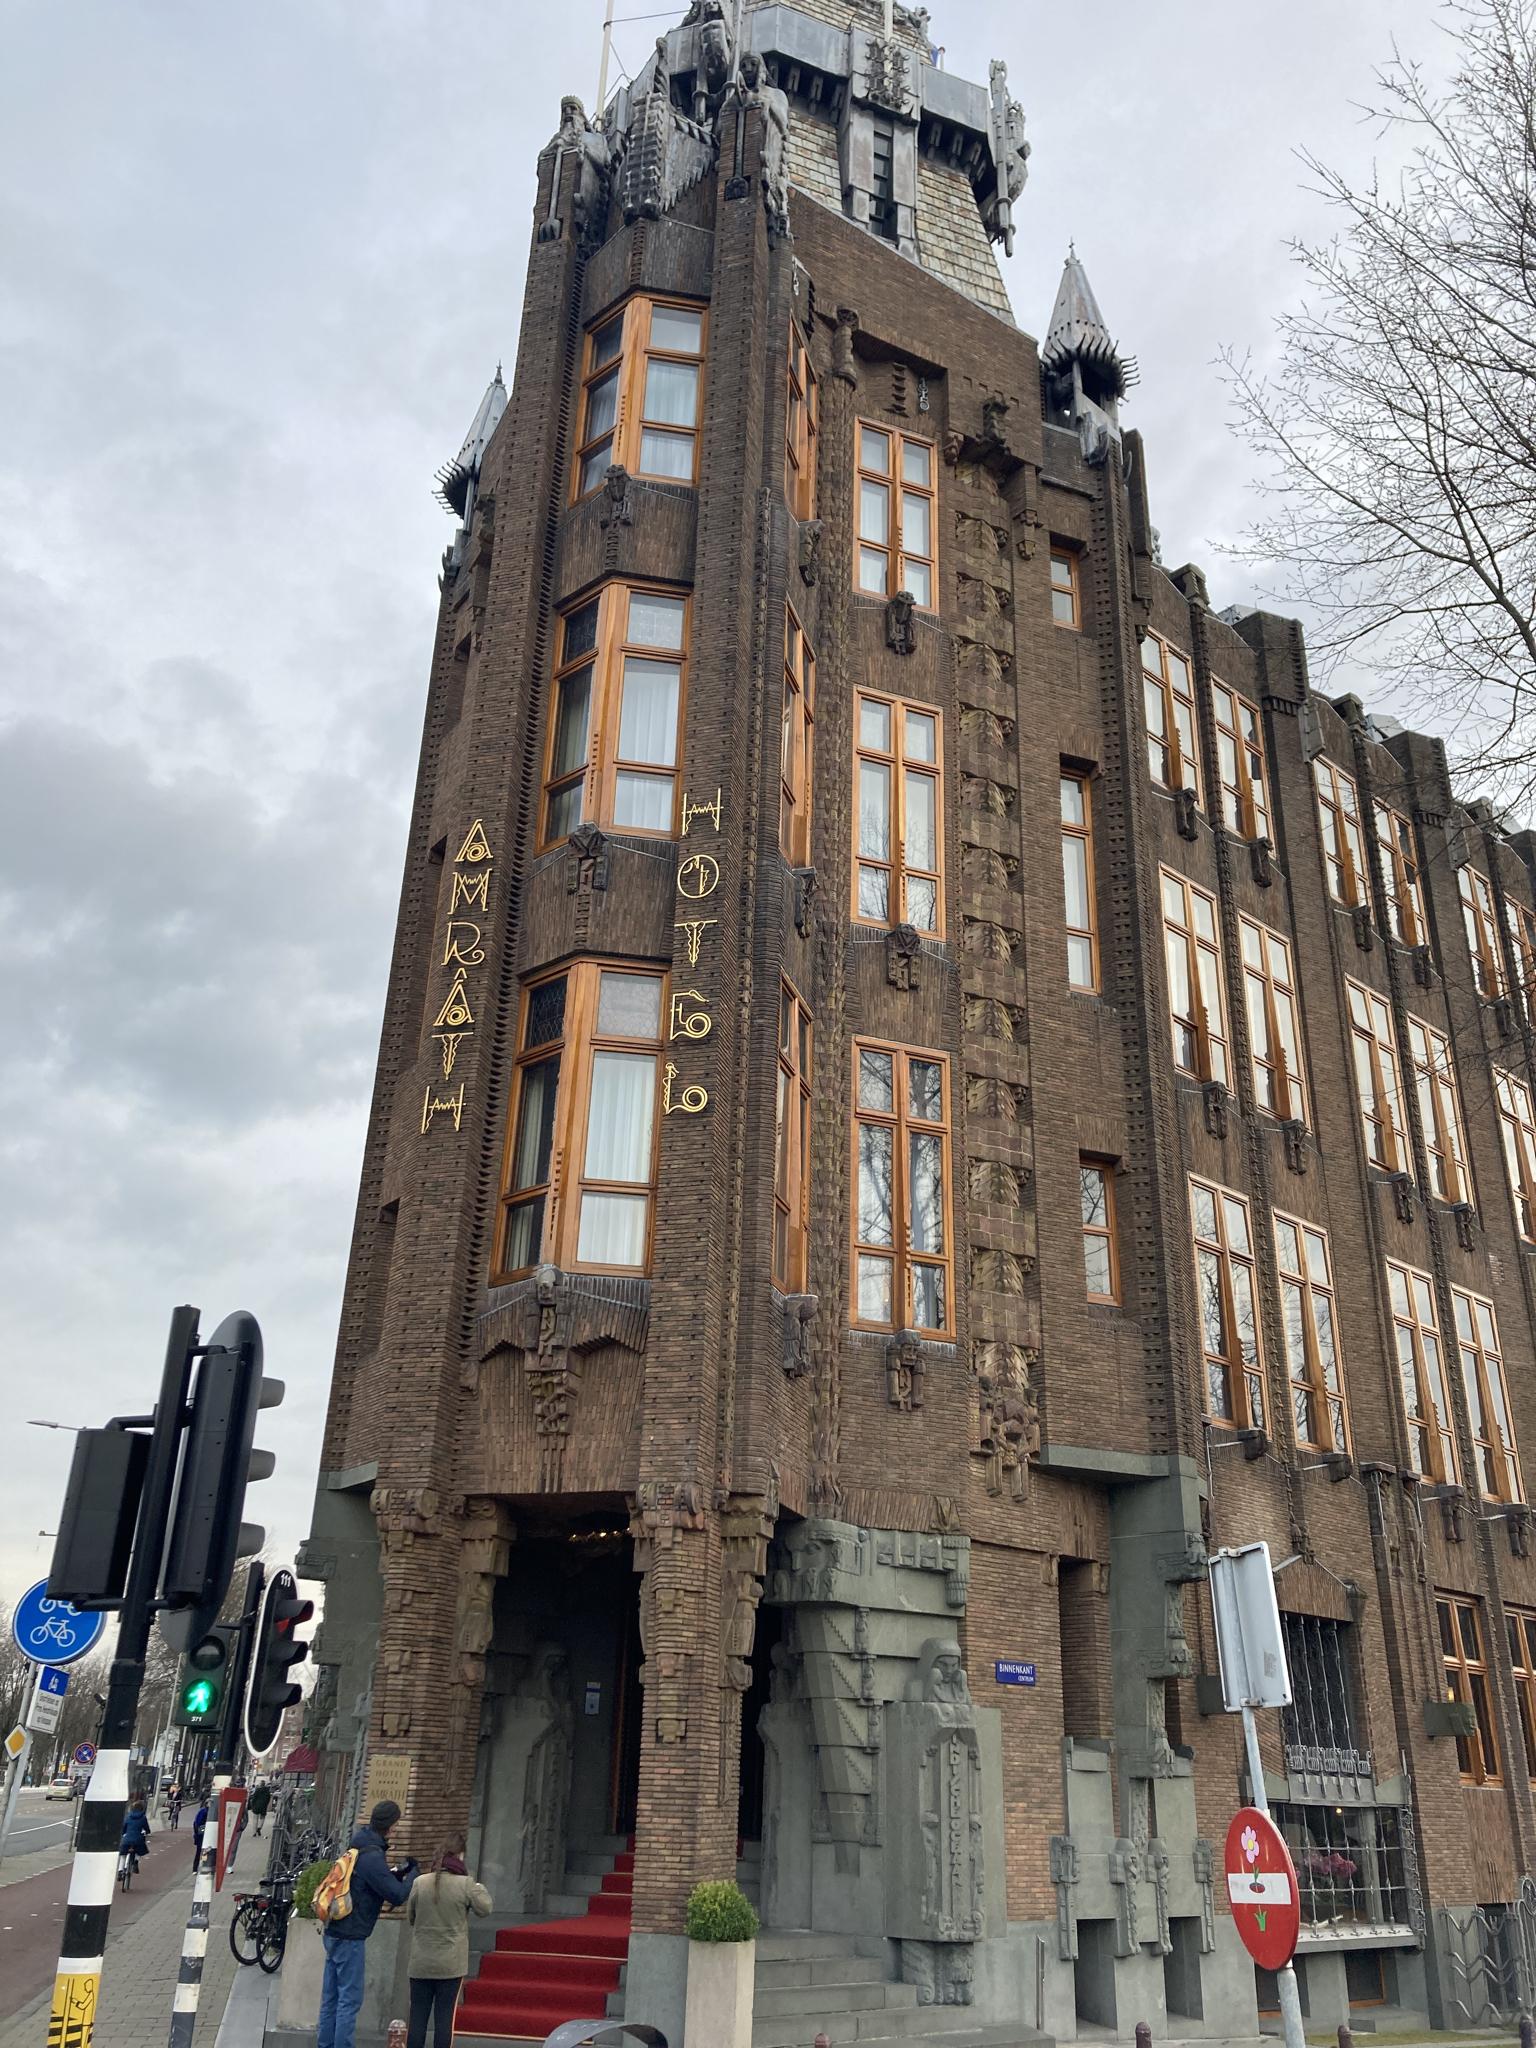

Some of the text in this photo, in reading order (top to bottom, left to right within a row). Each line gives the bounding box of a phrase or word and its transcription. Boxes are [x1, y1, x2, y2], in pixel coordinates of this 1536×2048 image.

[663, 788, 724, 1115] HOTEL
[281, 1573, 292, 1587] 111
[999, 1663, 1033, 1675] BINNENKANT
[375, 1759, 407, 1767] GRAND
[375, 1770, 403, 1778] HOTEL
